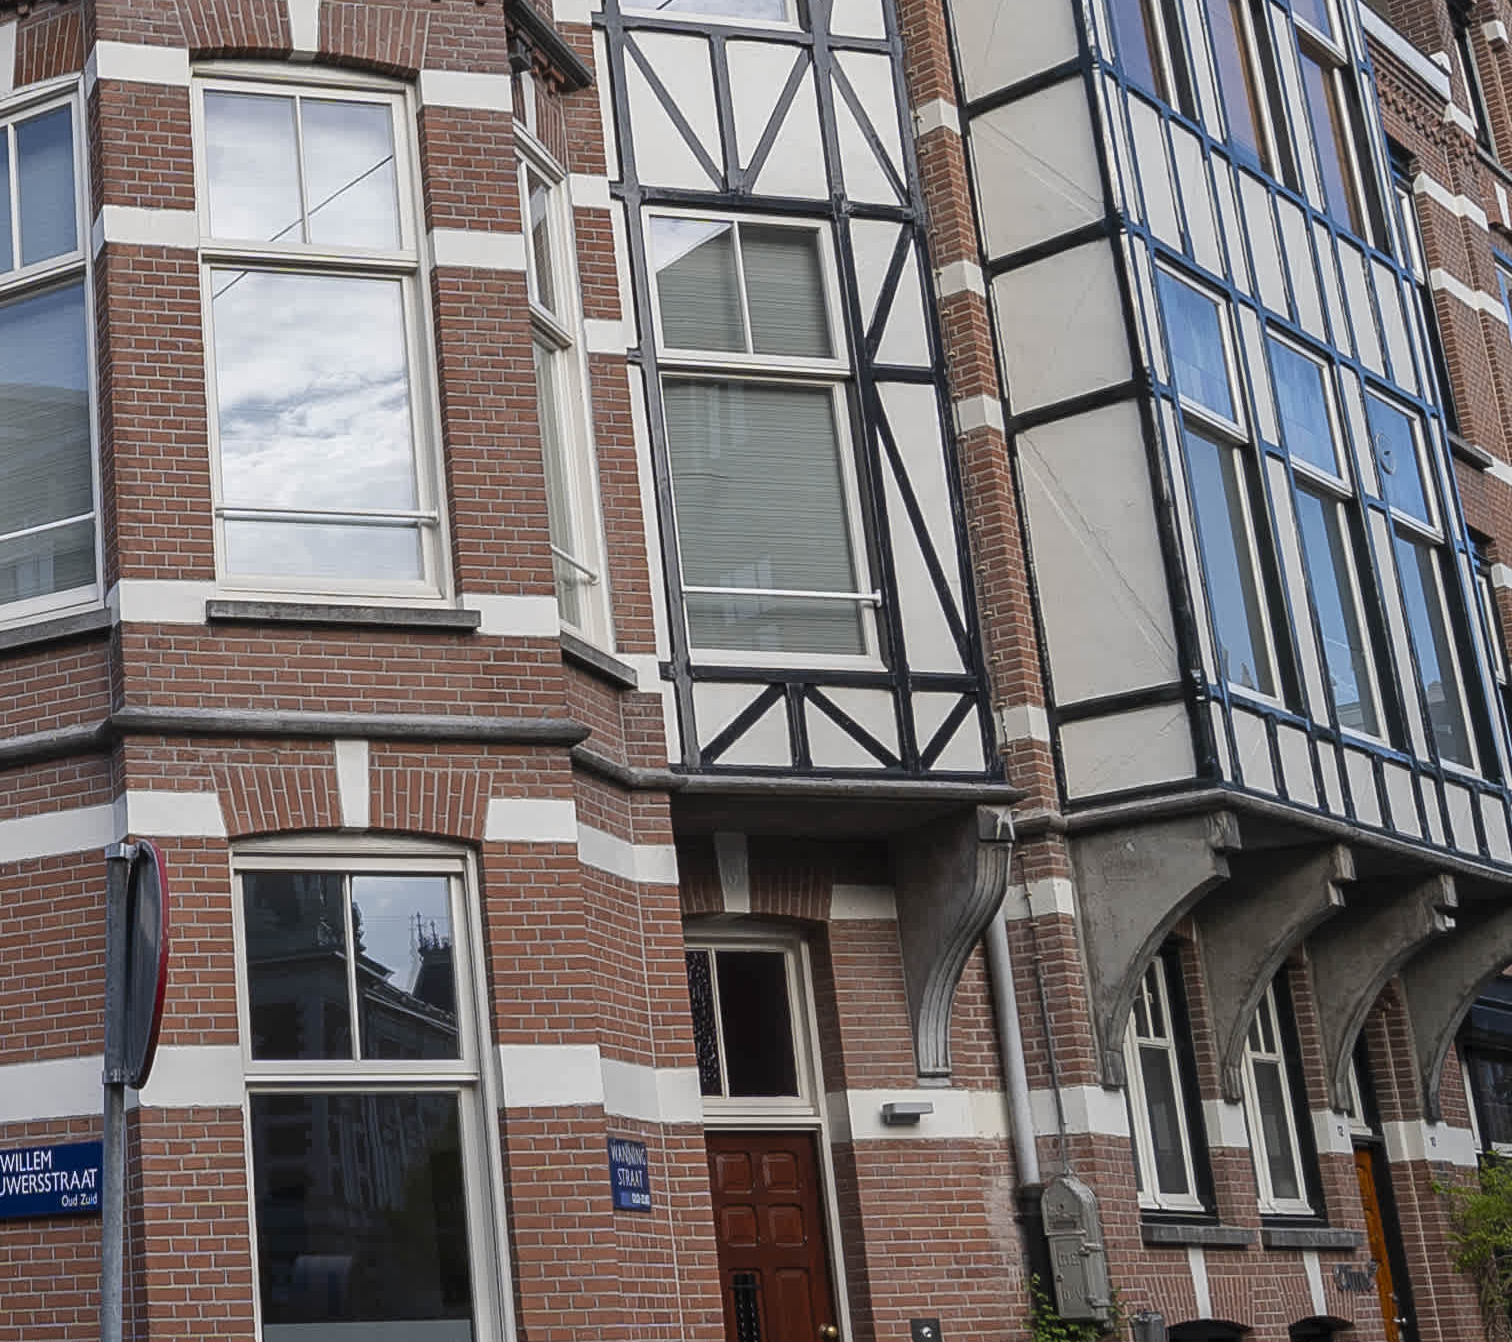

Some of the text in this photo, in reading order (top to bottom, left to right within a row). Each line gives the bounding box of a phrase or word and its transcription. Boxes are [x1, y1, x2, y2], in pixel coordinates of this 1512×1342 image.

[0, 1150, 53, 1173] WILLEM
[610, 1145, 646, 1166] WANNING
[617, 1168, 643, 1187] STRAAT
[61, 1193, 98, 1207] Oud Zuid
